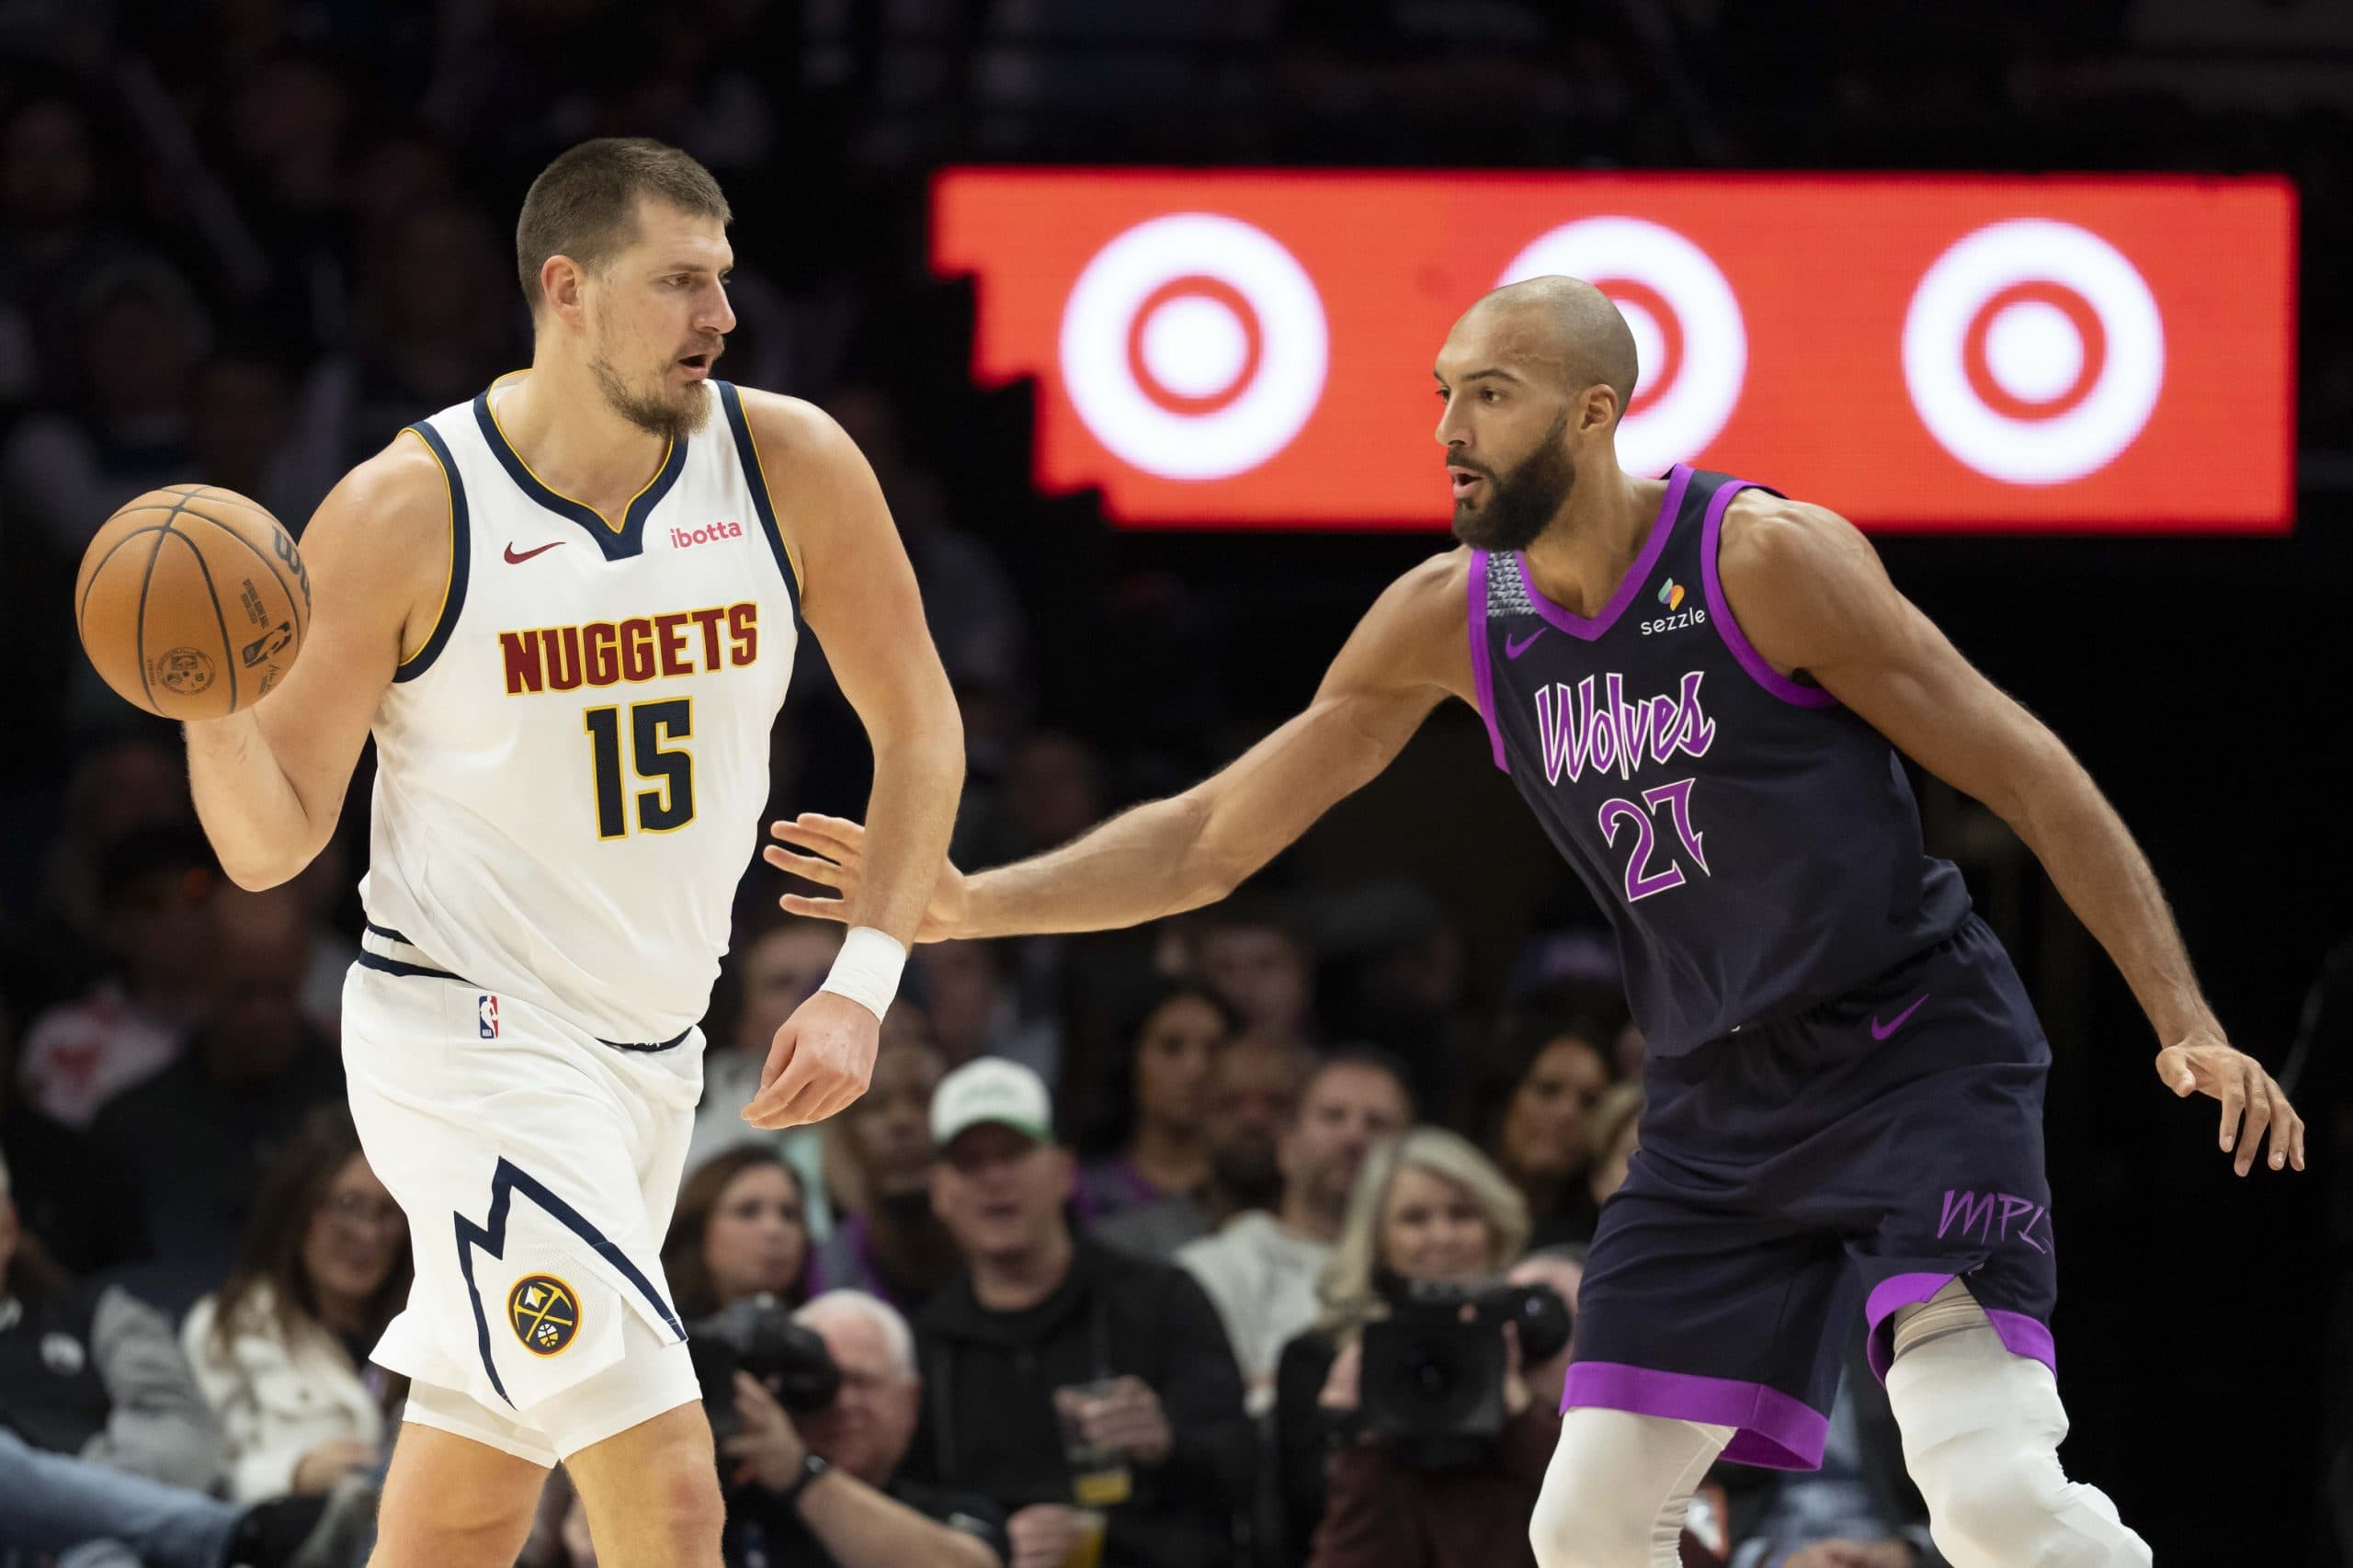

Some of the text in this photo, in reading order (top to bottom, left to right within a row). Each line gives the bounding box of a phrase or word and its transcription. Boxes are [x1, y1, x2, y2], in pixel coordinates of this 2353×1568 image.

[670, 521, 742, 549] ibotta
[498, 602, 757, 696] NUGGETS
[1641, 608, 1705, 636] sezzle
[583, 696, 697, 841] 15
[1535, 671, 1715, 786] Wolves
[1598, 778, 1710, 902] 27
